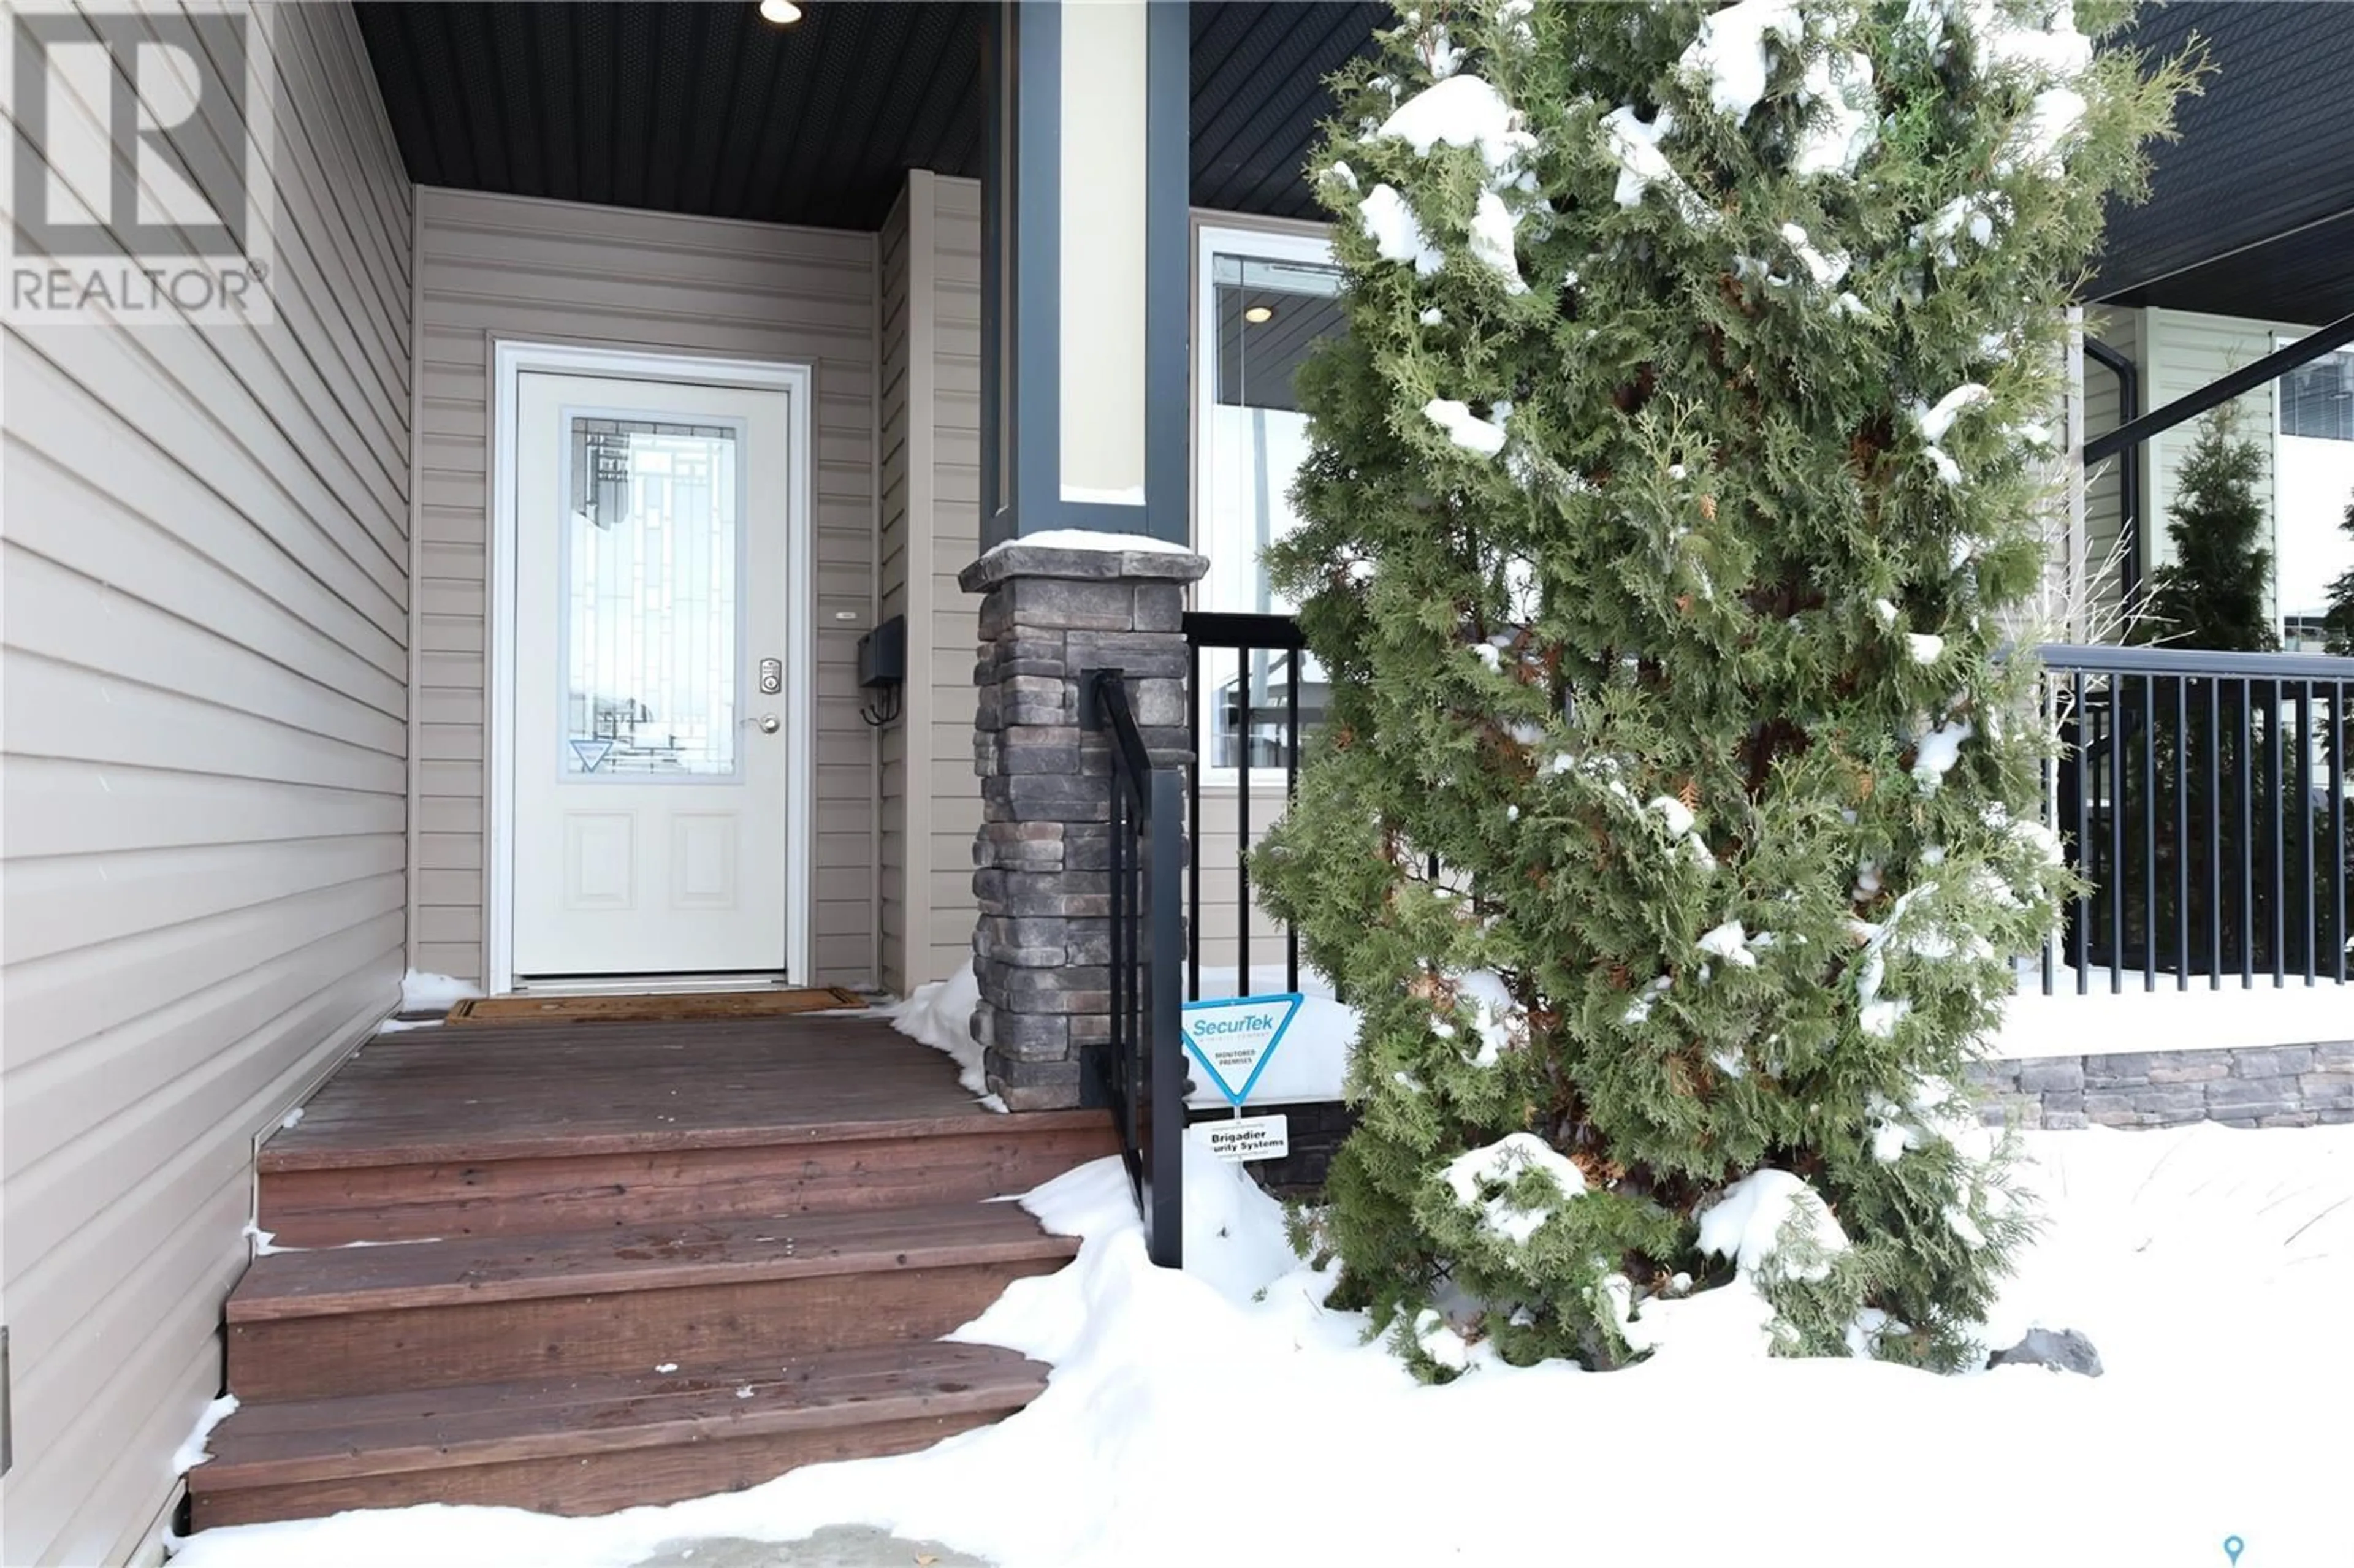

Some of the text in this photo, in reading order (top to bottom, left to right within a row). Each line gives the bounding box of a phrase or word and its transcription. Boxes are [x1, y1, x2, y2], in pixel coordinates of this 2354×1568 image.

[1192, 1013, 1273, 1036] SecurTek
[1214, 1049, 1256, 1059] MONITORED
[1211, 1130, 1266, 1143] Brigadier
[1213, 1139, 1284, 1152] urity Systems
